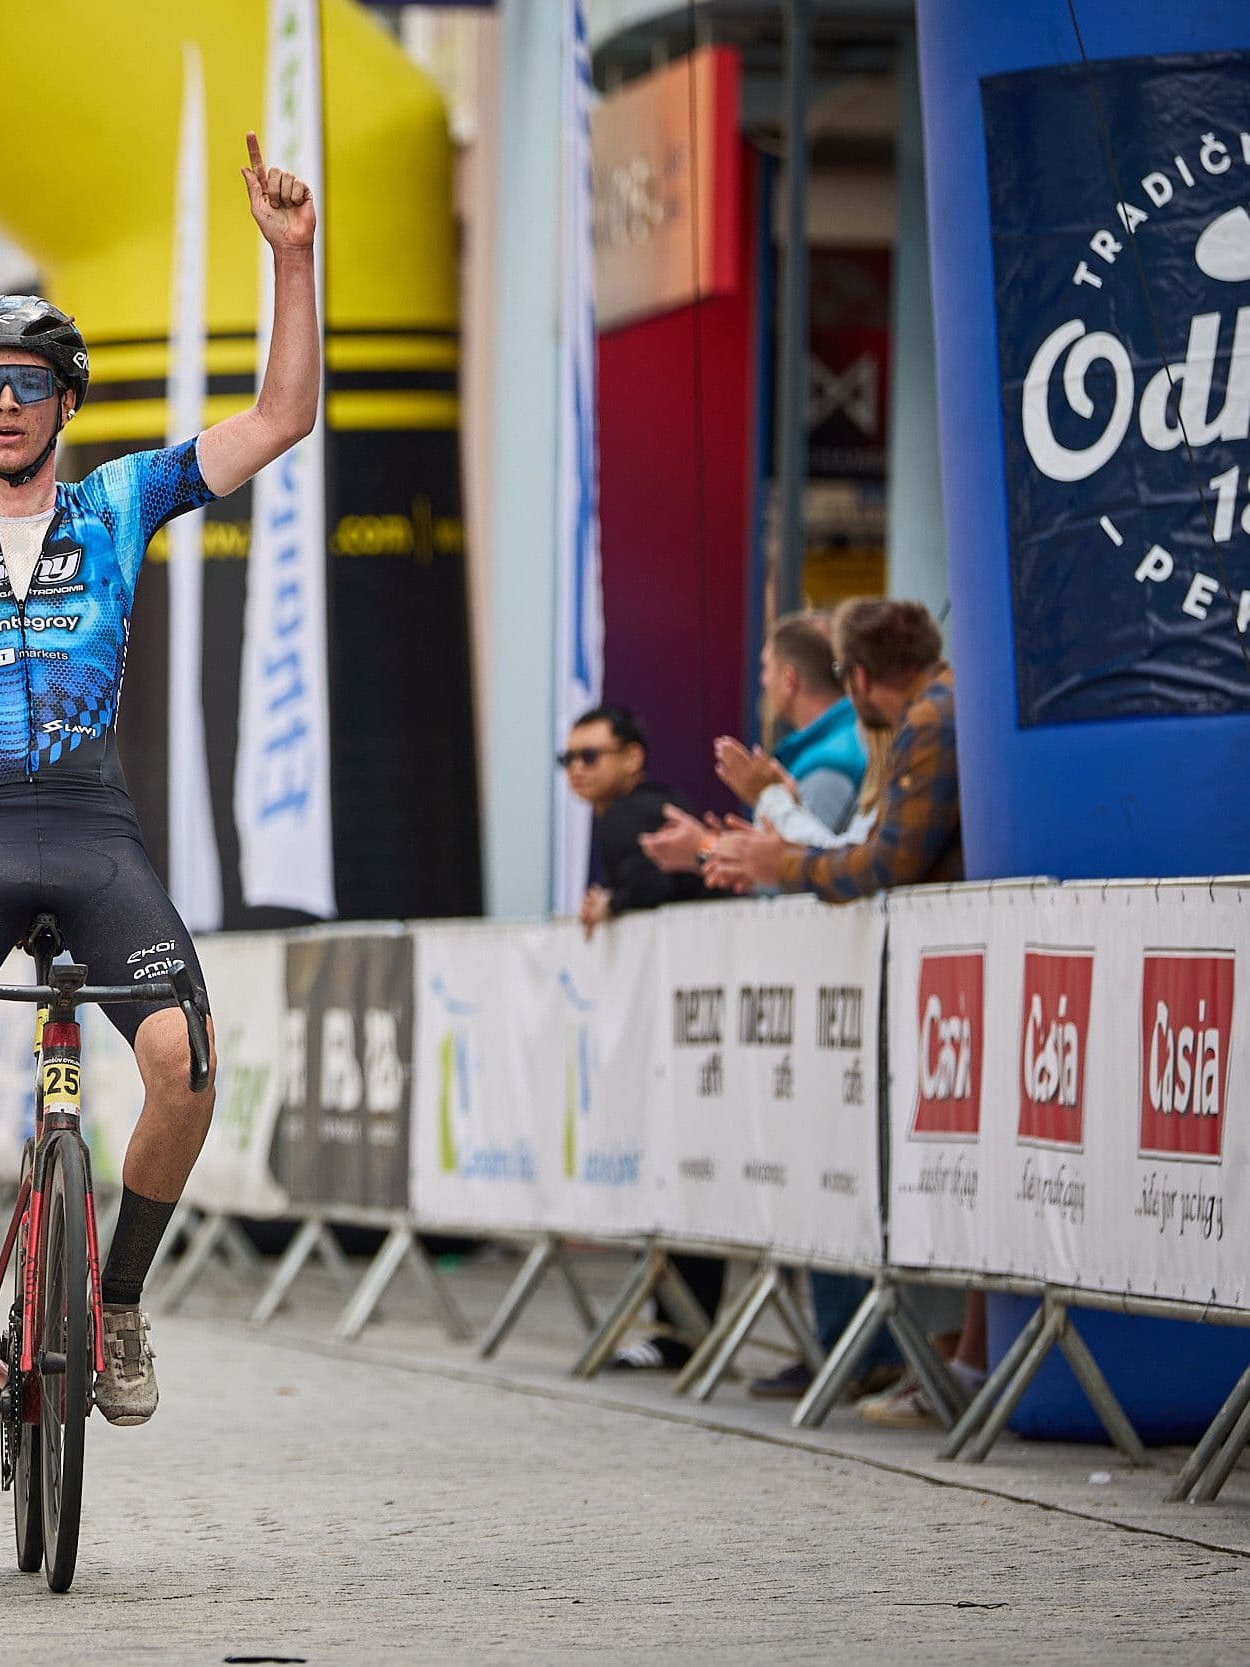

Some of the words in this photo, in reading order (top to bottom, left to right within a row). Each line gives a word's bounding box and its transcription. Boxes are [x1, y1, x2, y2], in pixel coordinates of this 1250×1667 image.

[1209, 465, 1250, 543] 1
[19, 649, 69, 661] markets
[44, 1066, 81, 1097] 25
[1149, 1000, 1220, 1118] Casia
